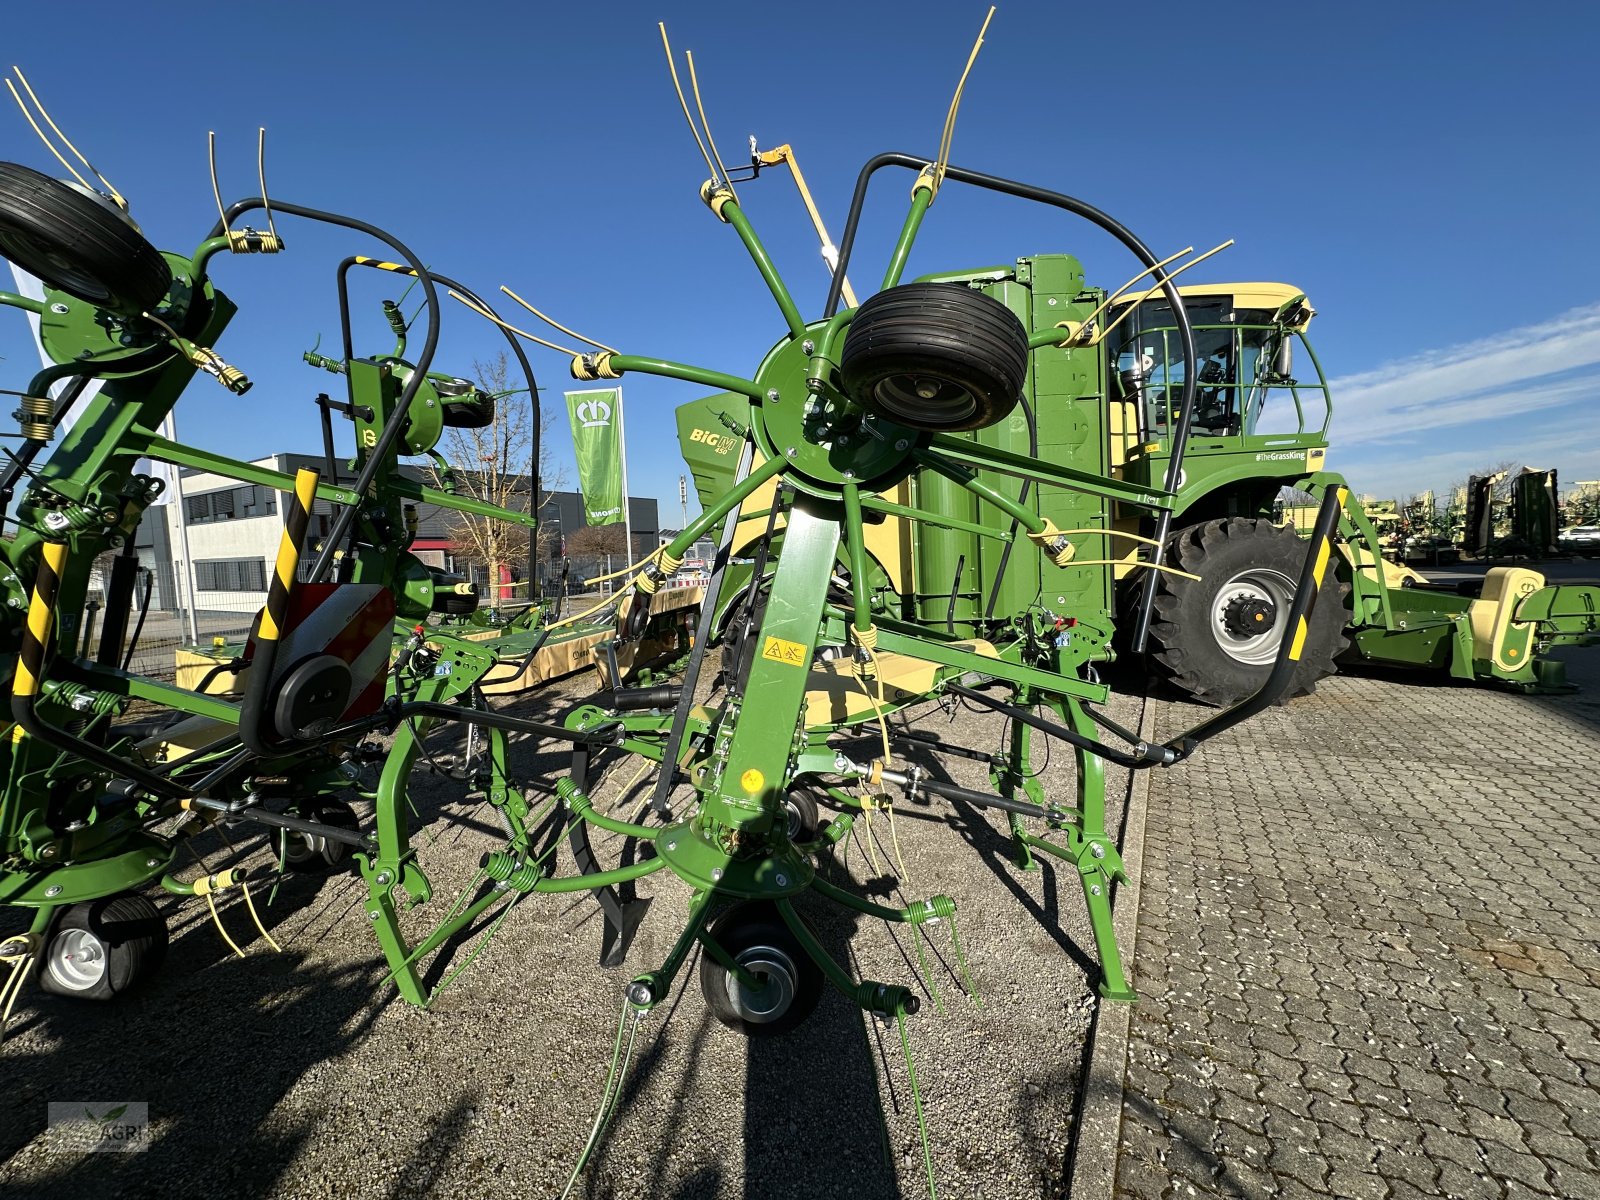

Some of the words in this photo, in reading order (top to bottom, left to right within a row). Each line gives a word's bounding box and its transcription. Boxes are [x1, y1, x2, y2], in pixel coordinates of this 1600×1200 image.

[689, 428, 720, 446] BiG
[717, 436, 737, 451] M
[714, 447, 728, 455] 450
[1256, 451, 1305, 462] #TheGrassKing
